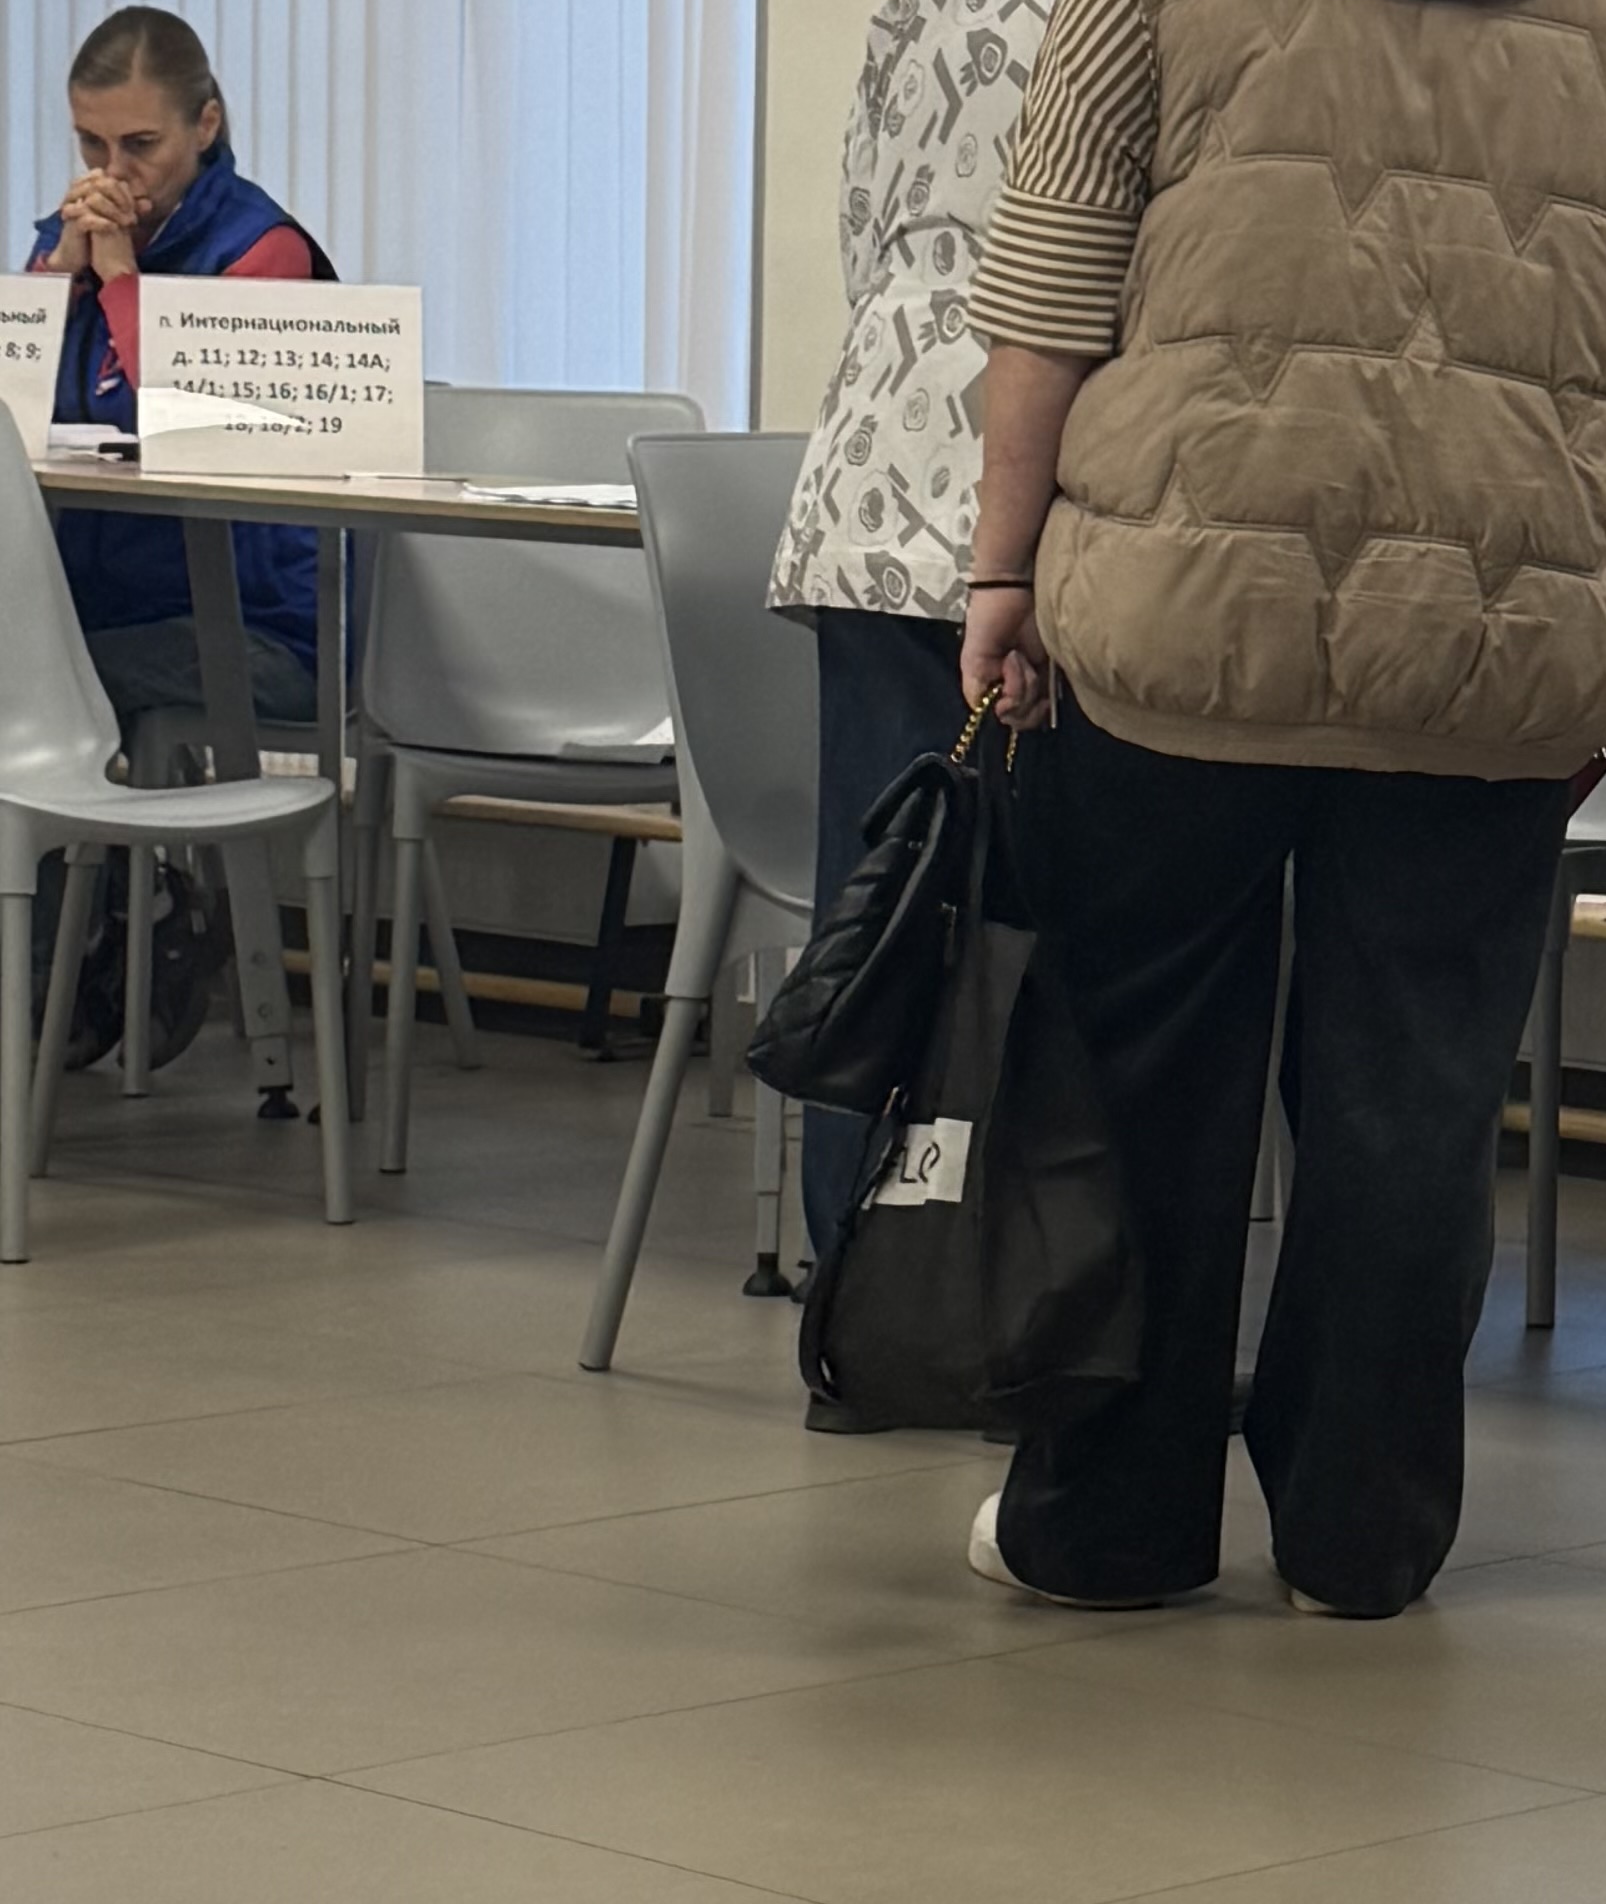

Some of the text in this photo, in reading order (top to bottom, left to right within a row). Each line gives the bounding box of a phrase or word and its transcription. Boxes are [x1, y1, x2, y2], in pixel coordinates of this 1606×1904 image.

[180, 312, 401, 335] Интернациональный
[26, 342, 42, 362] 9;
[171, 348, 392, 372] д. 11; 12; 13; 14; 14А;
[232, 381, 261, 400] 15;
[268, 382, 299, 402] 16;
[305, 384, 357, 404] 16/1;
[363, 385, 393, 405] 17;
[320, 417, 343, 433] 19
